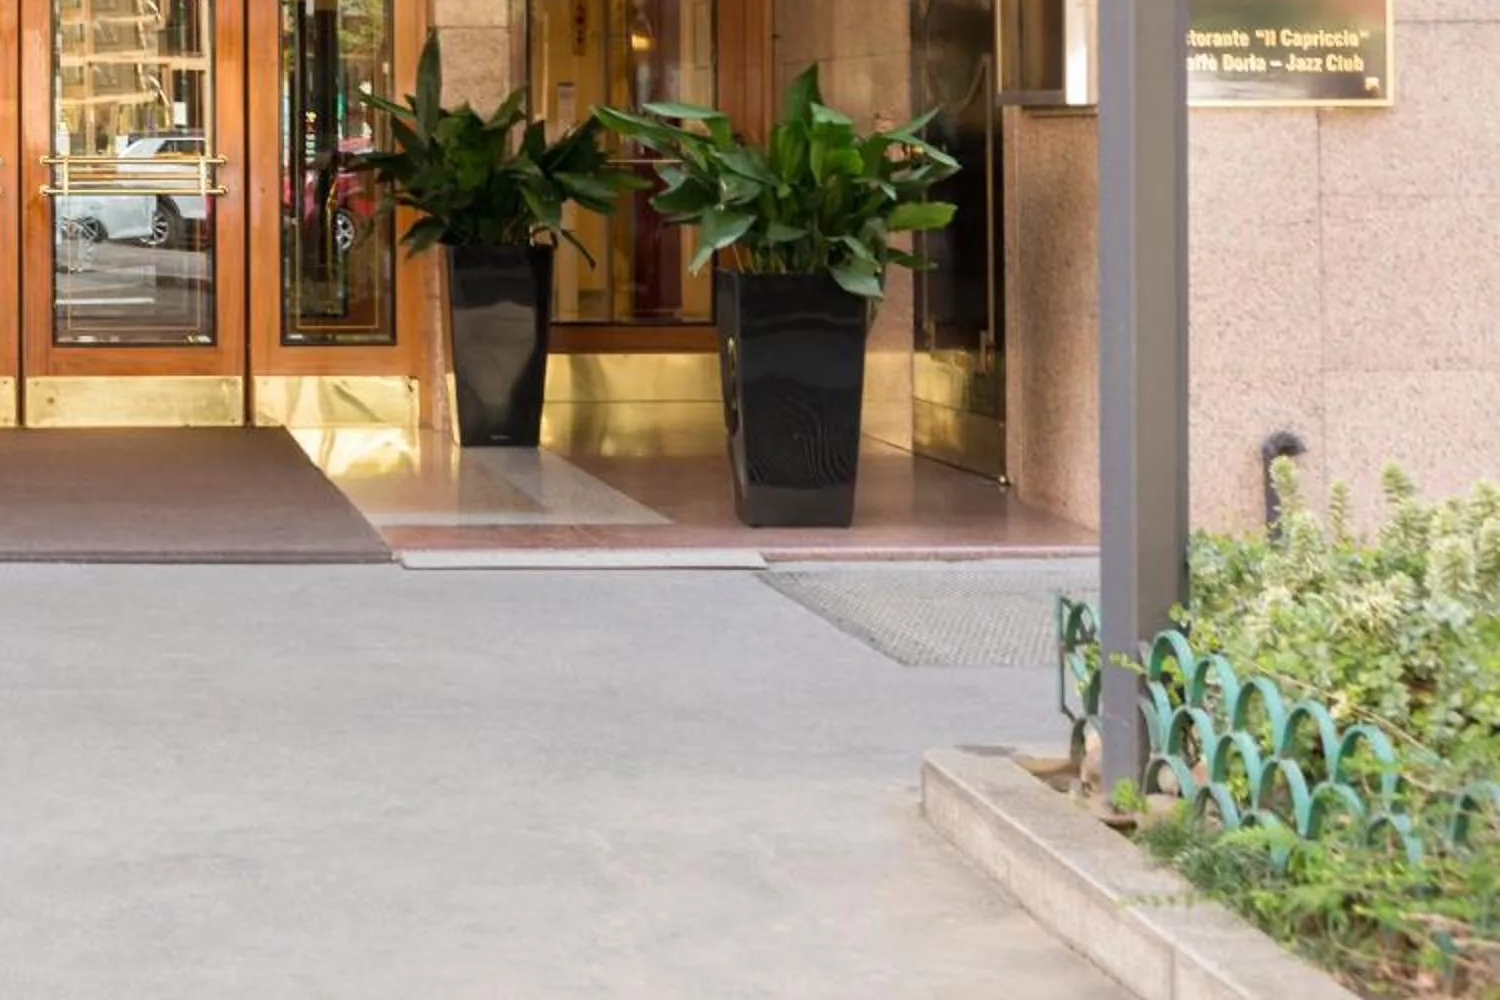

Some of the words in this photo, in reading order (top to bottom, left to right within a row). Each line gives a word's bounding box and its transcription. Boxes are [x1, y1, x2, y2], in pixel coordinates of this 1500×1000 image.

[1187, 29, 1250, 47] torante
[1187, 53, 1218, 71] affè
[1222, 53, 1266, 72] Doria
[1286, 53, 1323, 72] Jazz
[1326, 53, 1364, 72] Club
